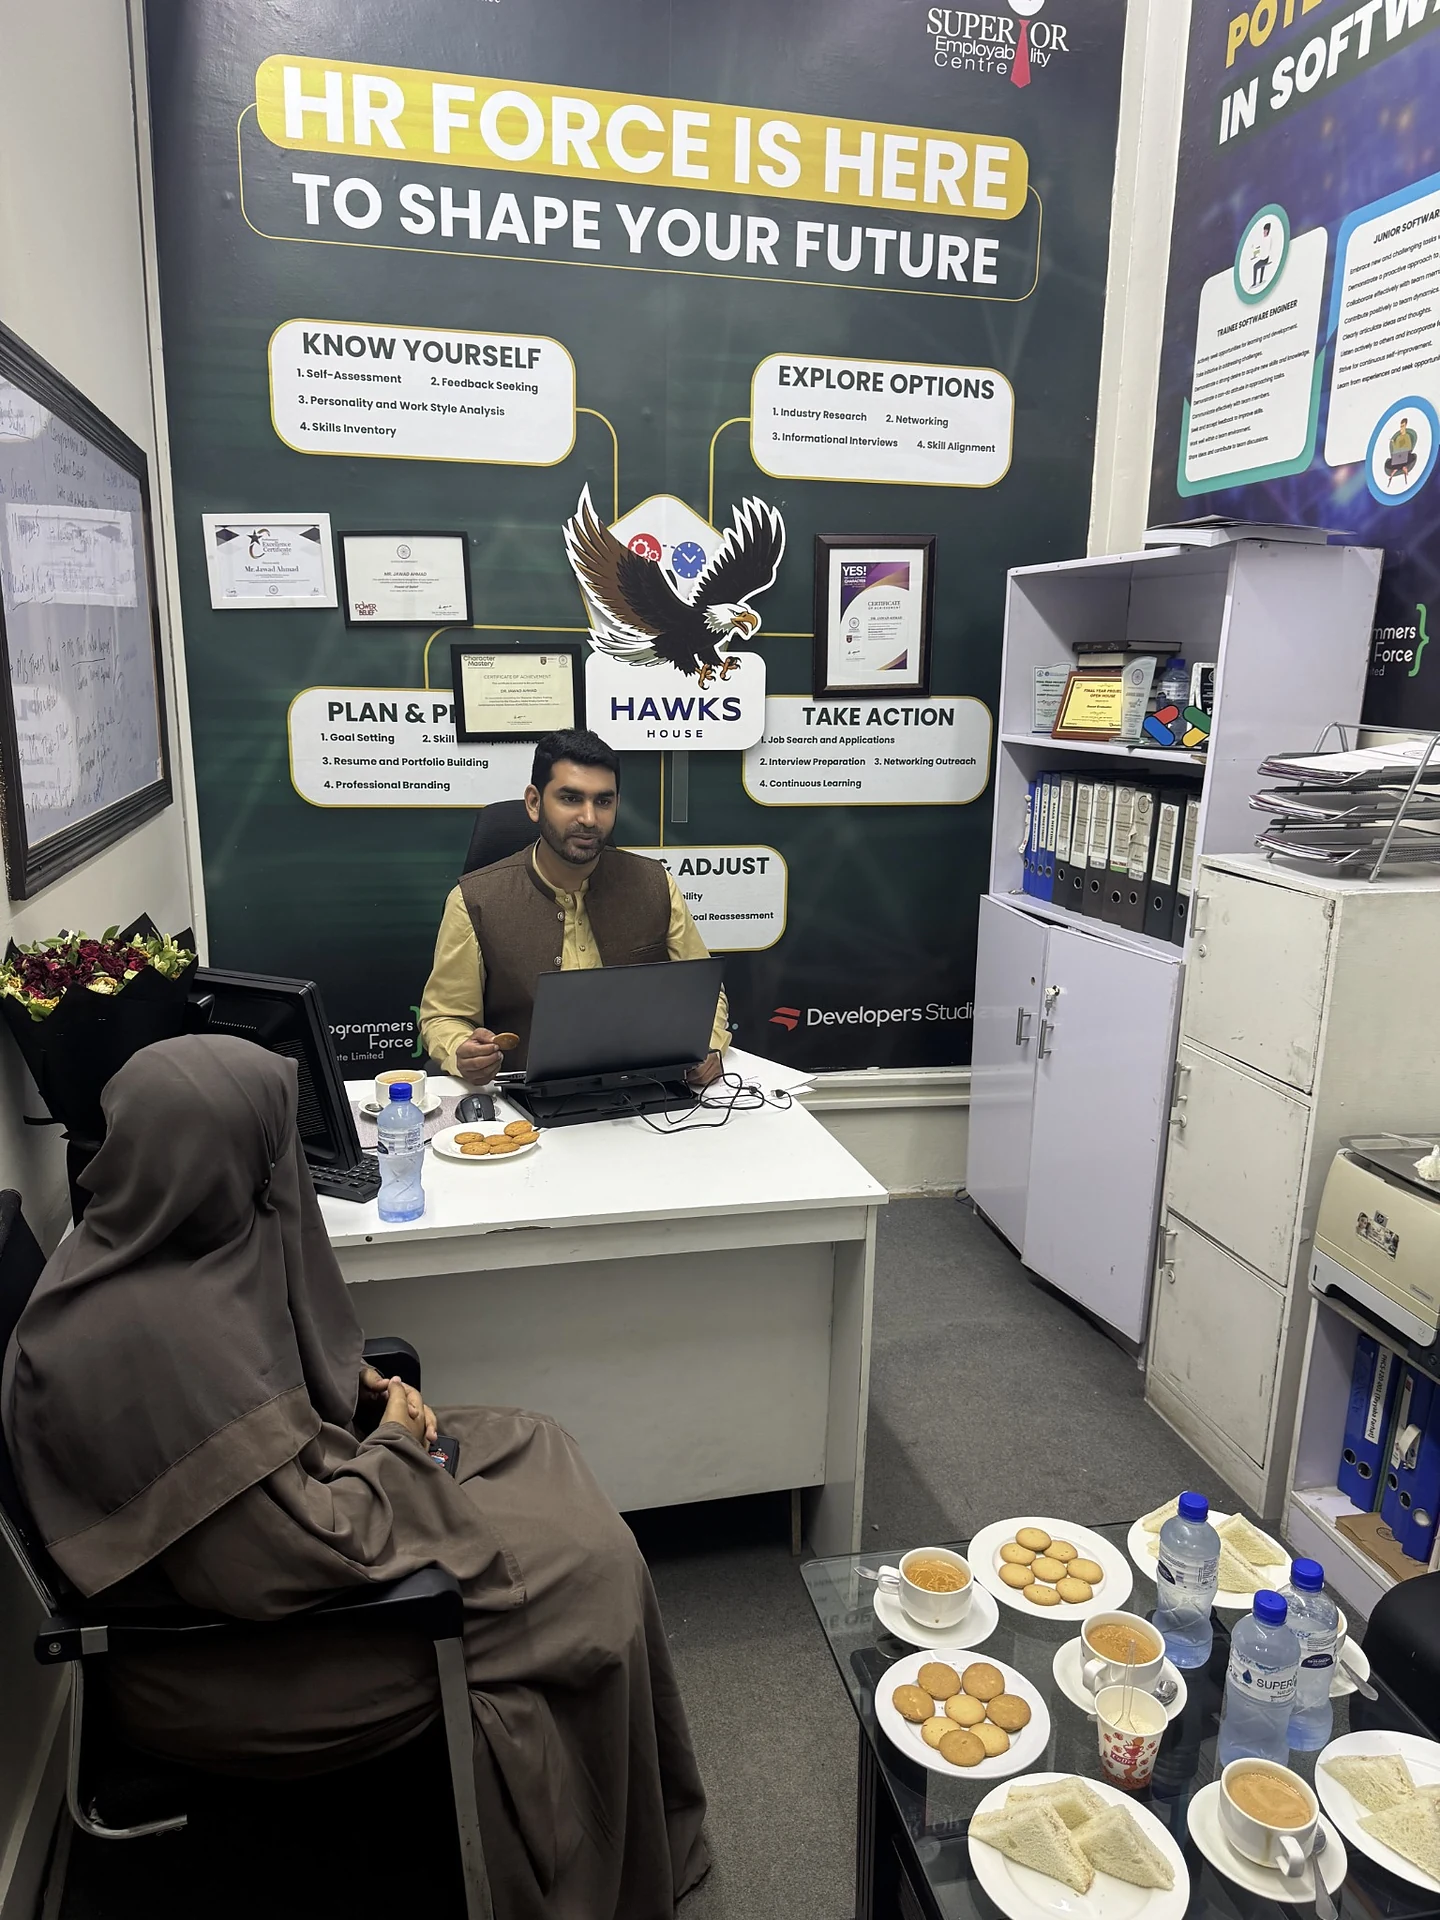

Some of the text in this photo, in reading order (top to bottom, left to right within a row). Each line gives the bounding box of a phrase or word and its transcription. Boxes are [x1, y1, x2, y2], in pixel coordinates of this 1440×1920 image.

[934, 52, 1008, 74] Centre
[1219, 77, 1259, 145] IN
[283, 66, 1010, 211] HR FORCE IS HERE
[292, 172, 1000, 285] TO SHAPE YOUR FUTURE
[1373, 209, 1440, 244] JUNIOR SOFTWAR
[1217, 299, 1298, 337] TRAINEE SOFTWARE ENGINEER
[303, 332, 541, 369] KNOW YOURSELF
[296, 368, 402, 384] 1. Self-Assessment
[778, 365, 995, 400] EXPLORE OPTIONS
[430, 376, 539, 395] 2. Feedback Seeking
[298, 395, 505, 418] 3. Personality and Work Style Analysis
[772, 407, 867, 422] 1. Industry Research
[885, 414, 949, 428] 2. Networking
[299, 421, 397, 438] 4. Skills Inventory
[772, 432, 898, 447] 3. Informational Interviews
[917, 440, 996, 454] 4. Skill Alignment
[842, 566, 867, 576] YES!
[1374, 641, 1413, 662] Force
[327, 701, 398, 723] PLAN
[405, 703, 426, 724] &
[610, 697, 742, 722] HAWKS
[802, 707, 955, 727] TAKE ACTION
[321, 733, 395, 744] 1. Goal Setting
[422, 734, 455, 743] 2. Skill
[646, 729, 704, 739] HOUSE
[768, 735, 785, 745] Job
[787, 735, 818, 745] Search
[819, 736, 837, 744] and
[839, 736, 895, 746] Applications
[322, 757, 489, 769] 3. Resume and Portfolio Building
[760, 757, 866, 768] 2. Interview Preparation
[874, 757, 977, 768] 3. Networking Outreach
[324, 780, 451, 792] 4. Professional Branding
[759, 779, 862, 790] 4. Continuous Learning
[678, 857, 770, 877] ADJUST
[691, 911, 774, 921] oal Reassessment
[807, 1002, 976, 1028] Developers Studi
[329, 1022, 414, 1040] ogrammers
[369, 1034, 414, 1049] Force
[351, 1051, 384, 1061] Limited
[1256, 1678, 1295, 1690] SUPER
[1111, 1754, 1136, 1765] Coffee
